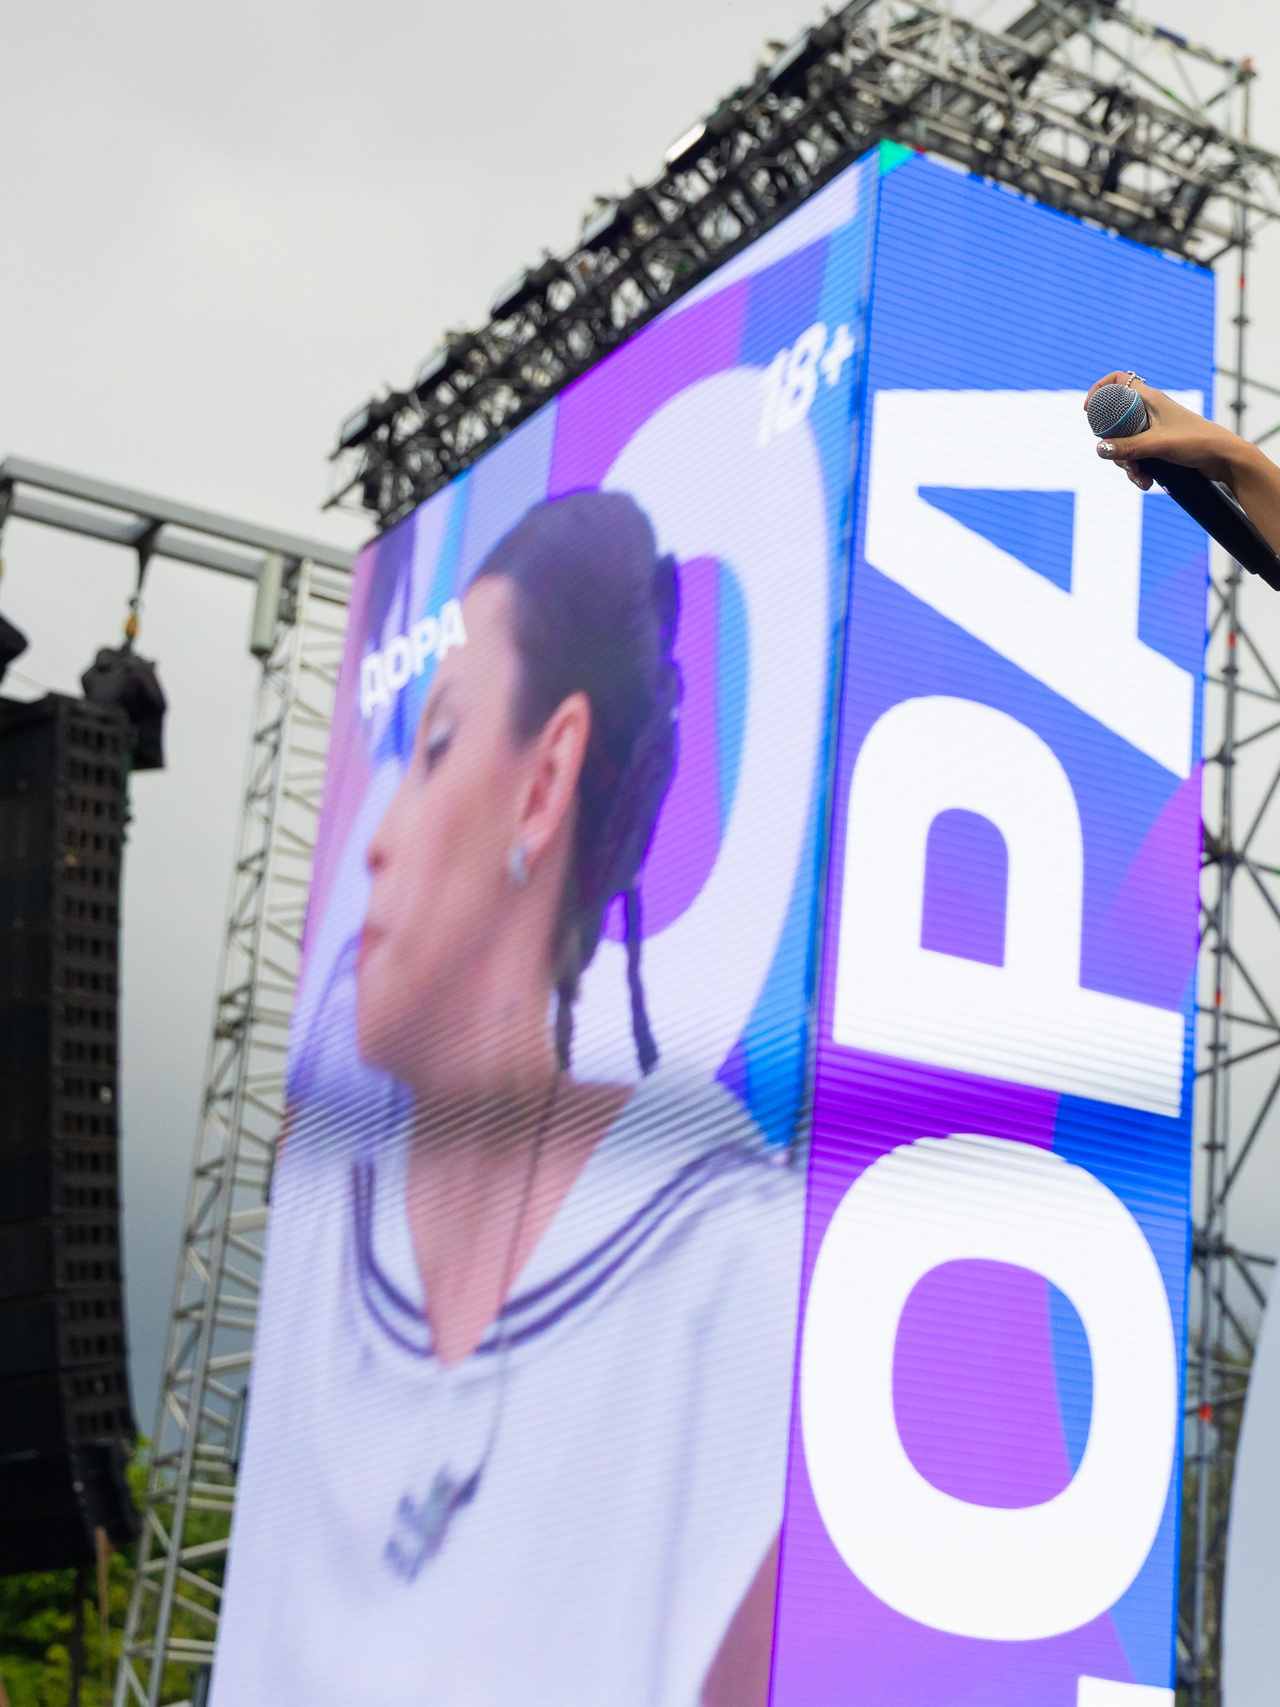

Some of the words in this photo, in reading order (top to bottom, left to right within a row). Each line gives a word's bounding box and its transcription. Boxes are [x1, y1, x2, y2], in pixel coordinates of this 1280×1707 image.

[756, 322, 856, 447] 18+
[360, 597, 467, 720] ДОРА
[801, 388, 1206, 1707] ОРА
